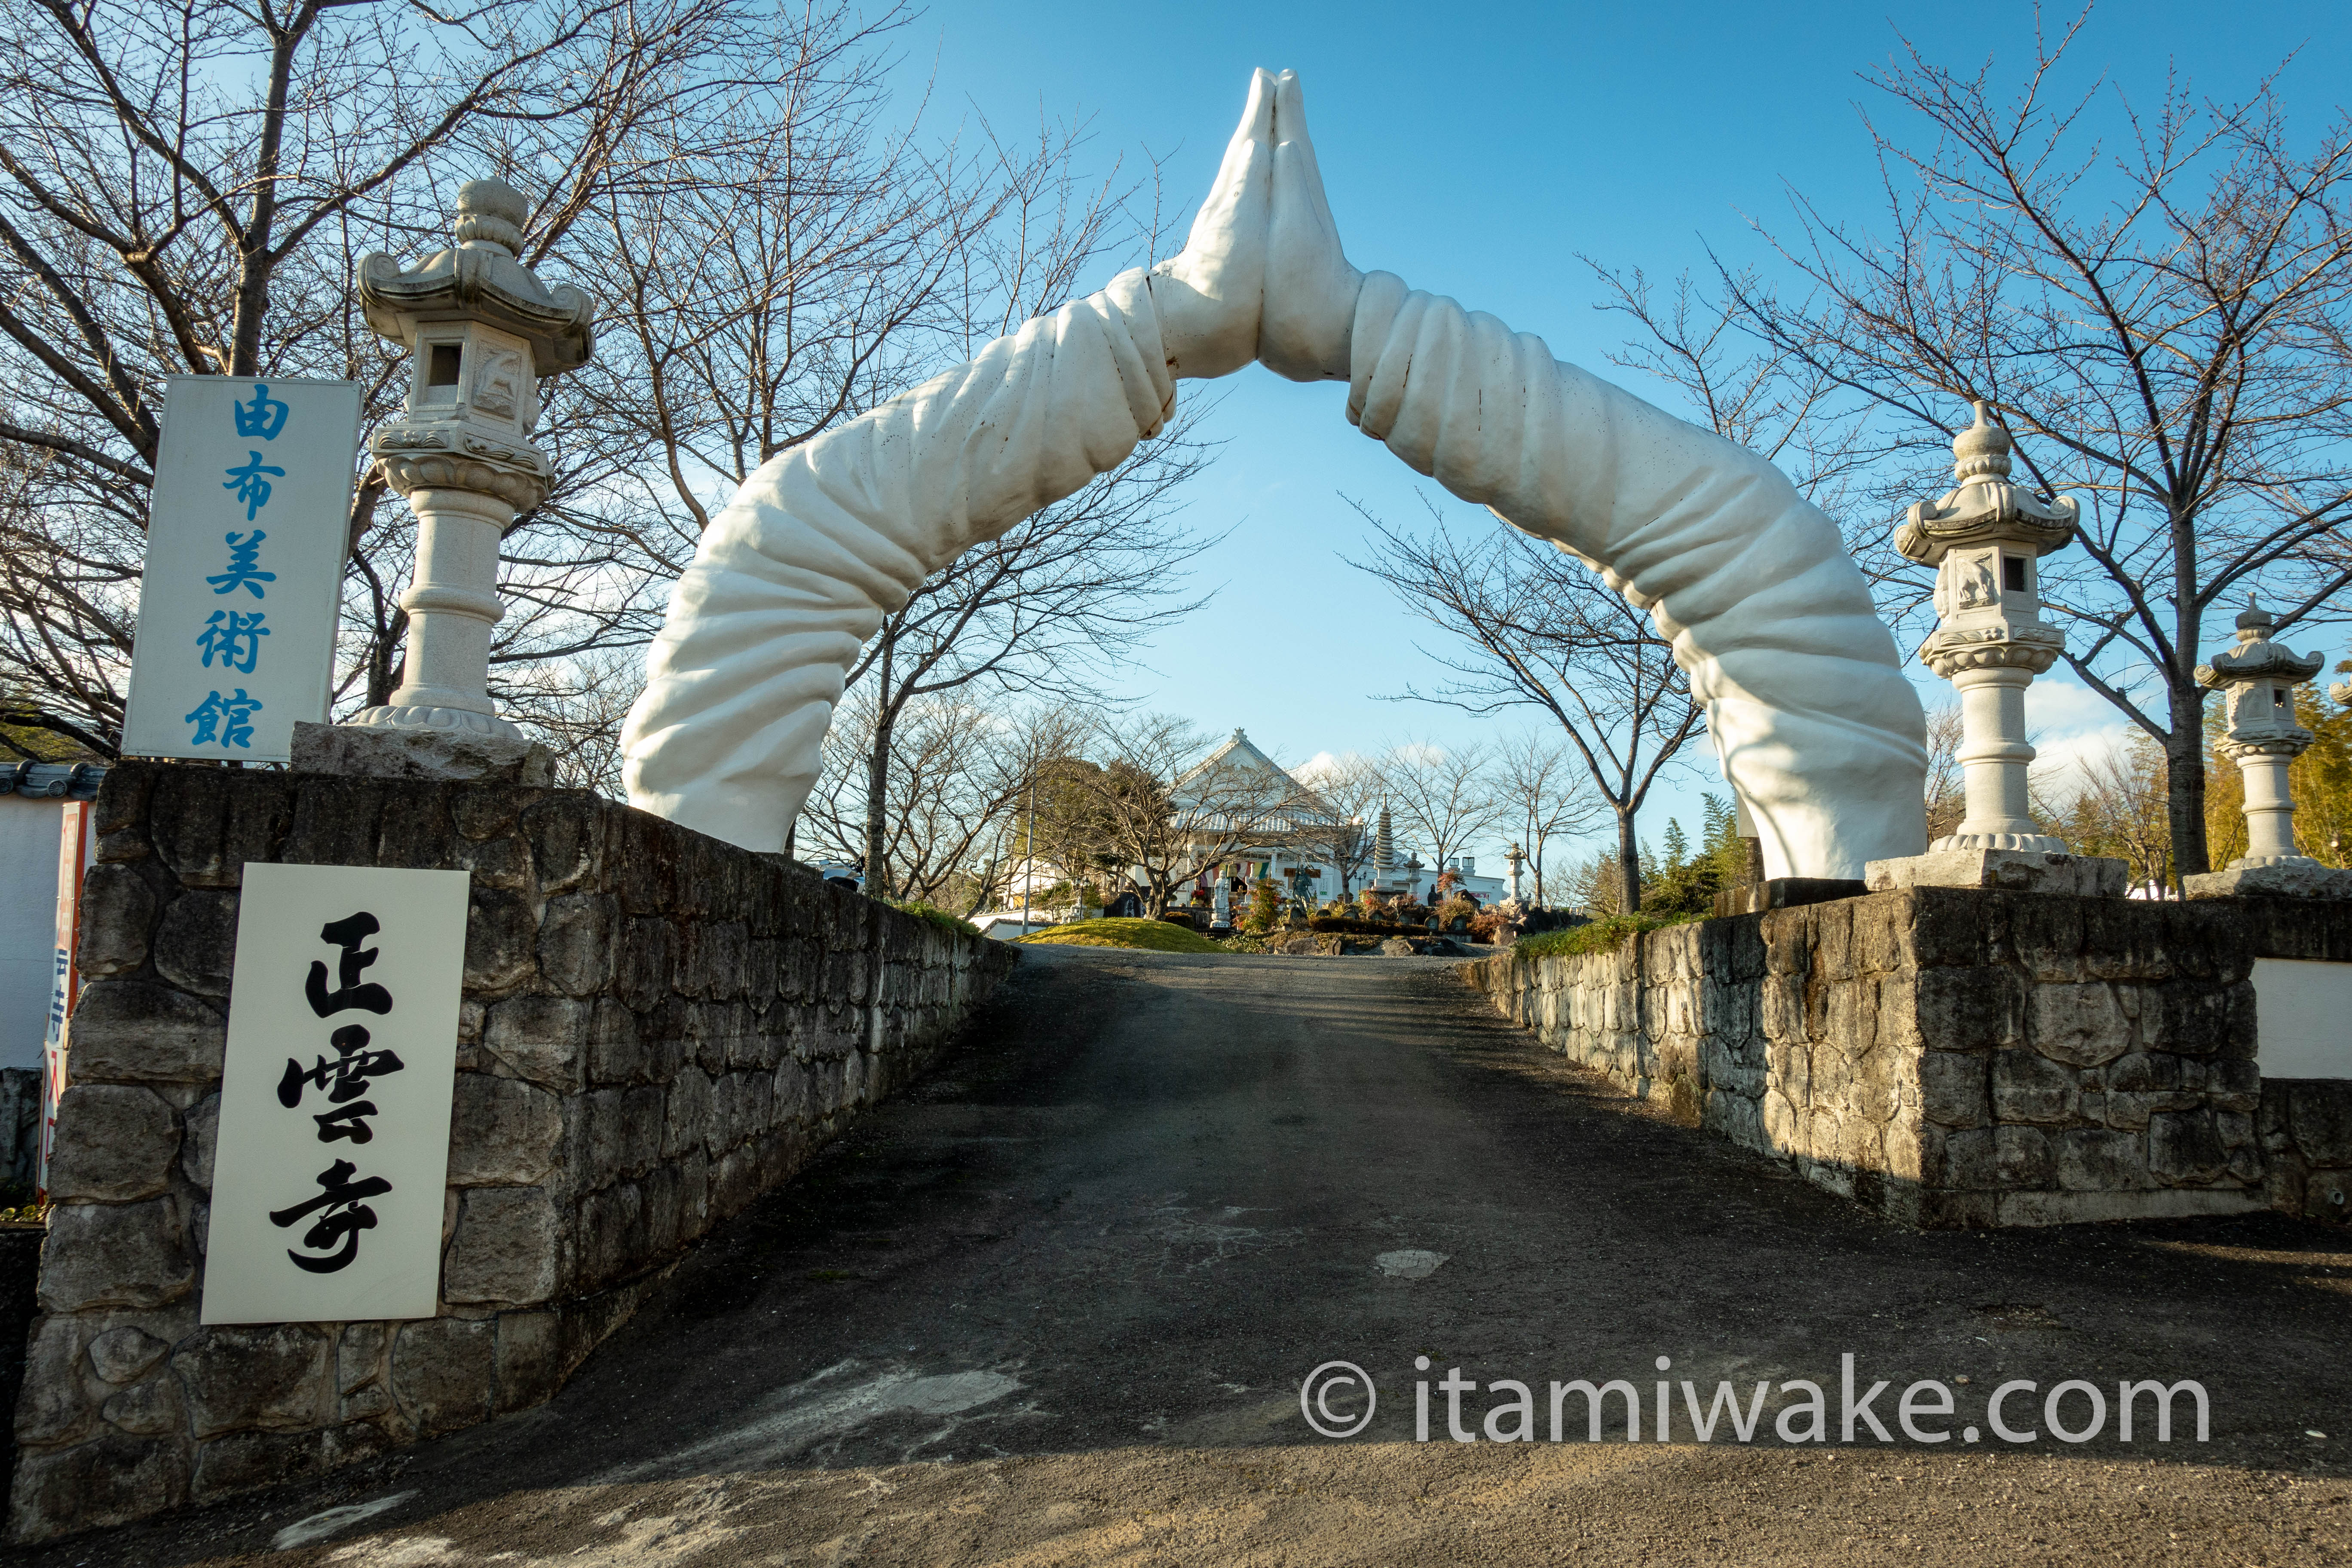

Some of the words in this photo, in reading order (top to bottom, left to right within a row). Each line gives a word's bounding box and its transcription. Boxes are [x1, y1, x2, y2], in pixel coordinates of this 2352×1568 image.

[185, 384, 289, 748] 由布美術館
[269, 912, 404, 1274] 正雲寺
